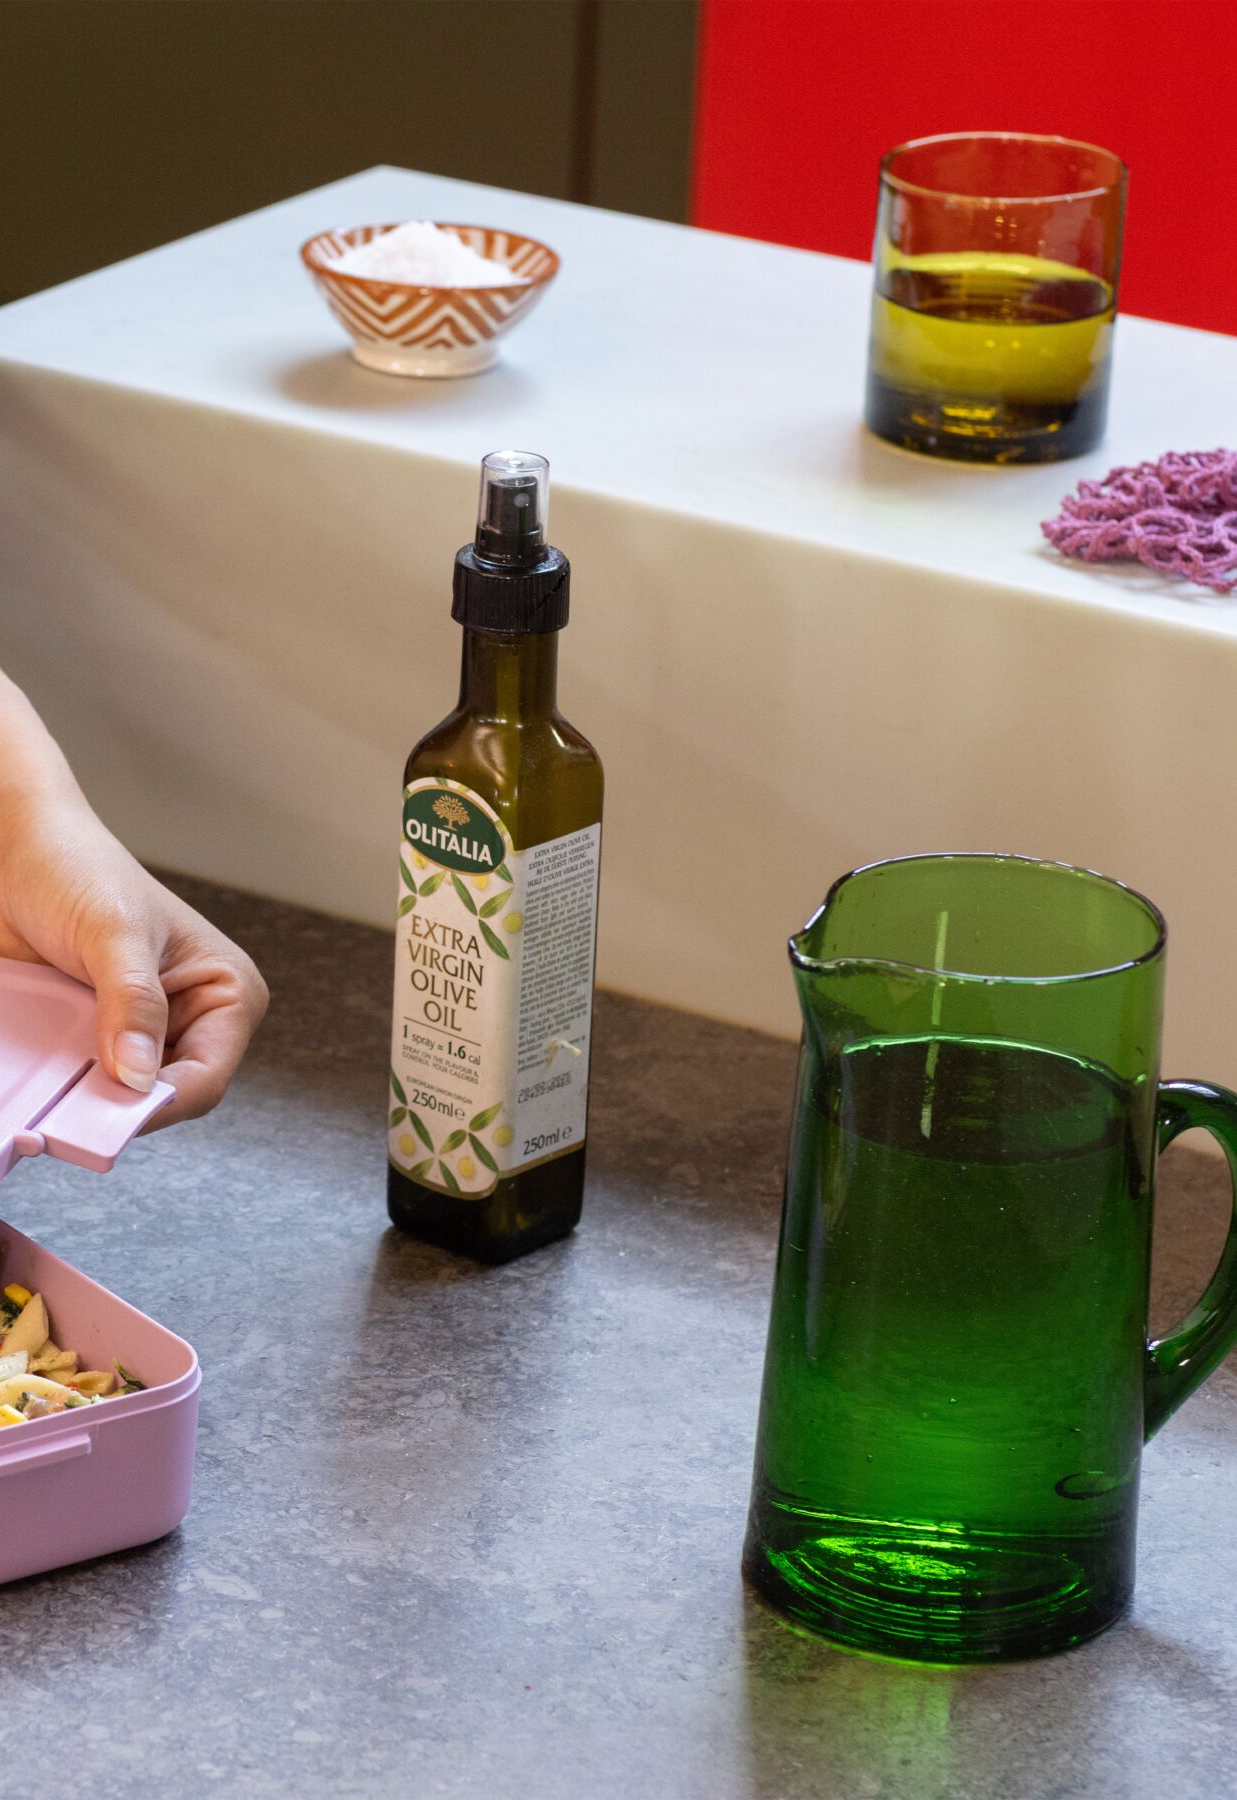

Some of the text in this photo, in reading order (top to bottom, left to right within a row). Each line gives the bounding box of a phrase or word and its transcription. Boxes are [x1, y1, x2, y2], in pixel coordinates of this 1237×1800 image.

[406, 819, 493, 867] OLITALIA
[534, 833, 590, 859] EXTRA VIRGIN OLIVE OIL
[527, 878, 542, 888] HUILE
[579, 858, 594, 869] EXTRA
[528, 860, 544, 870] EXTRA
[543, 865, 550, 873] DE
[411, 913, 482, 960] EXTRA
[407, 938, 485, 988] VIRGIN
[410, 968, 478, 1012] OLIVE
[423, 1000, 463, 1032] OIL
[402, 1044, 420, 1053] SPRAY
[421, 1051, 431, 1059] ON
[433, 1055, 444, 1064] THE
[445, 1060, 472, 1075] FLAVOUR
[403, 1024, 409, 1039] 1
[411, 1034, 435, 1050] spray
[448, 1041, 466, 1060] 1.6
[468, 1055, 481, 1066] cal
[402, 1051, 479, 1085] CONTROL YOUR CALORIES
[523, 1127, 560, 1156] 250ml
